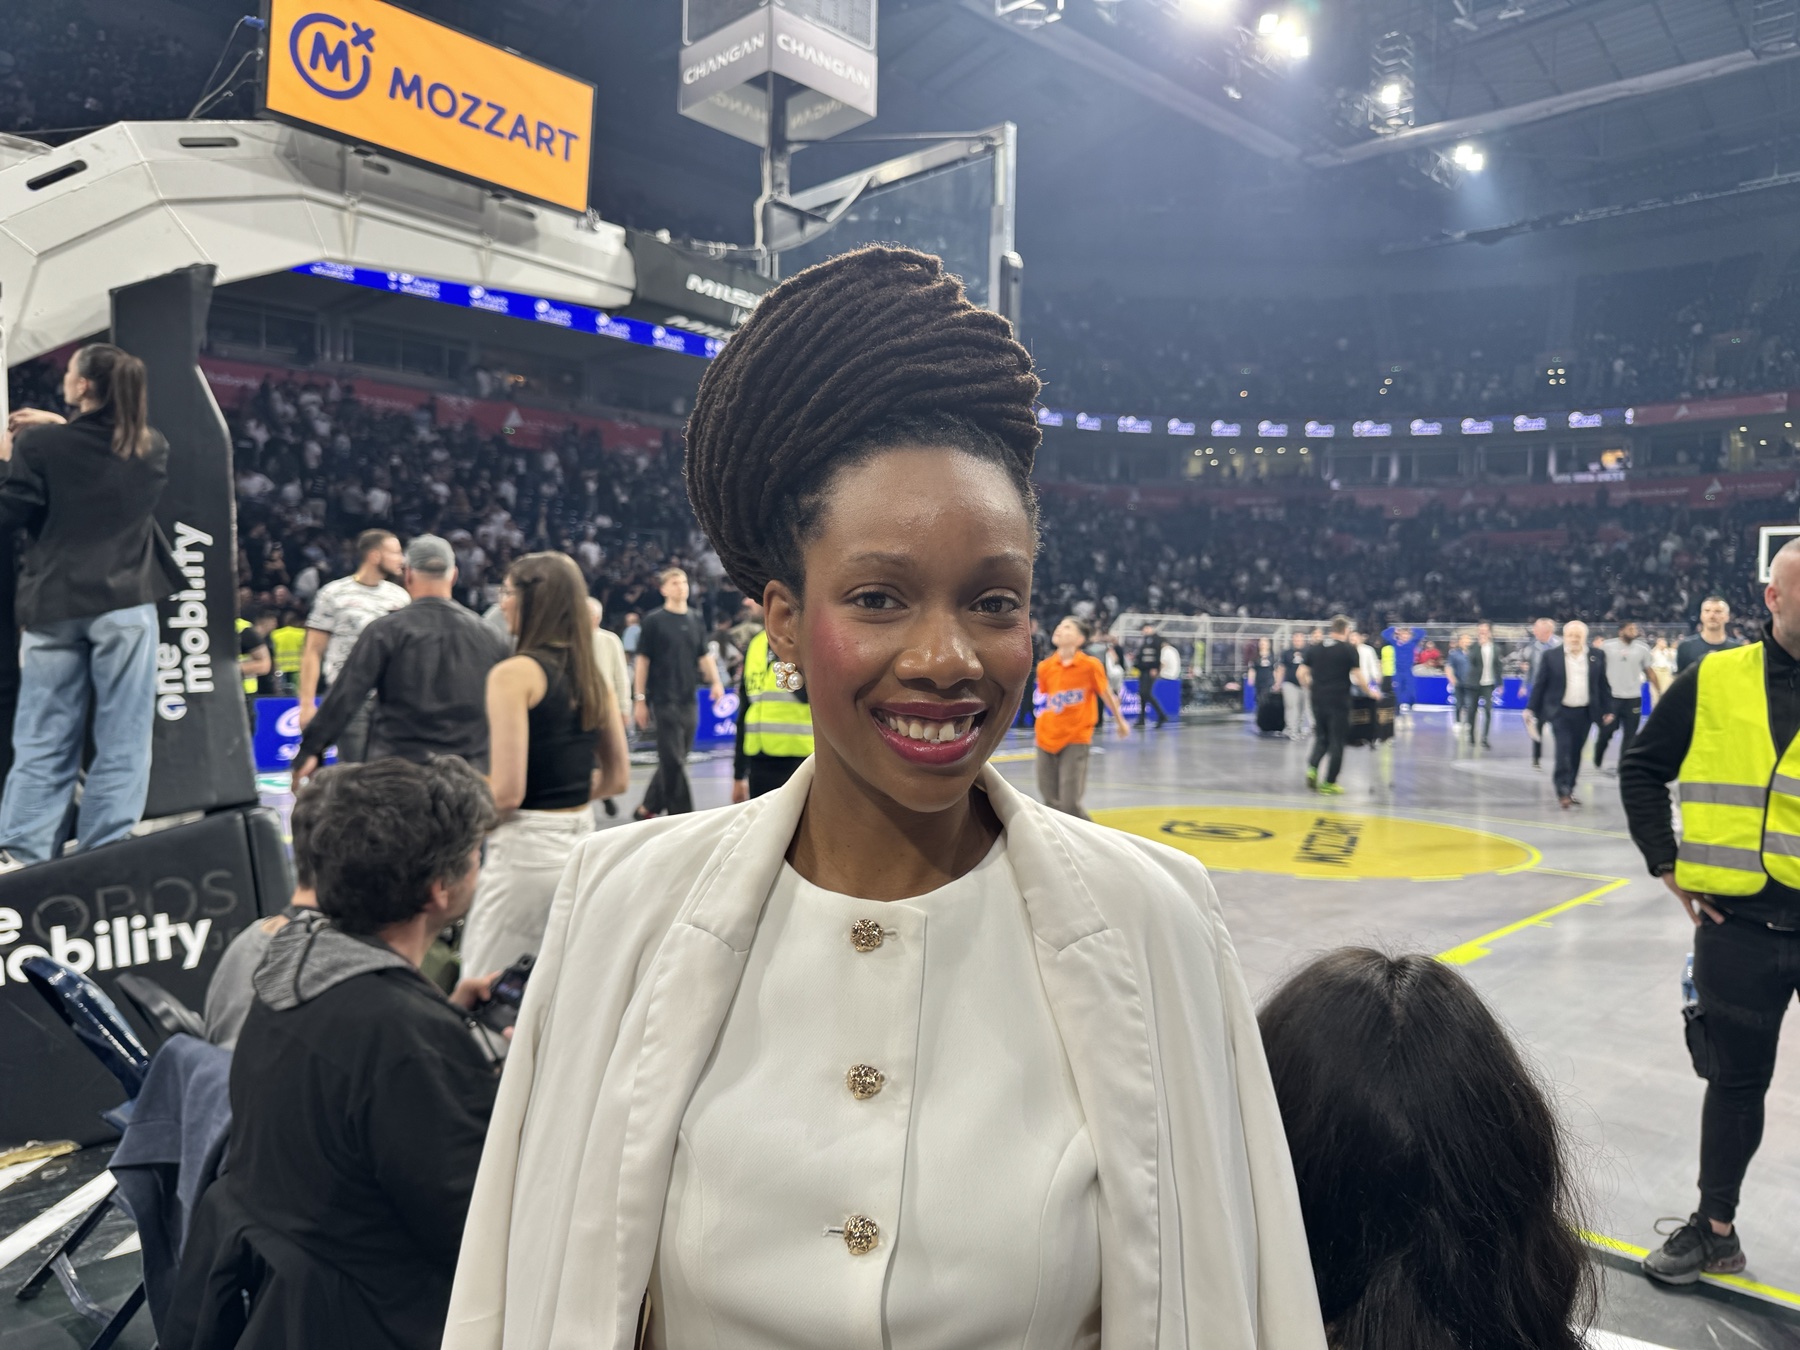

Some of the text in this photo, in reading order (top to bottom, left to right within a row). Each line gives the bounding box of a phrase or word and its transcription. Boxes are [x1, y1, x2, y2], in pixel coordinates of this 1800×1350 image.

[682, 32, 766, 86] CHANGAN
[776, 32, 871, 90] CHANGAN
[388, 66, 579, 162] MOZZART
[155, 642, 188, 721] one
[0, 912, 213, 986] obility
